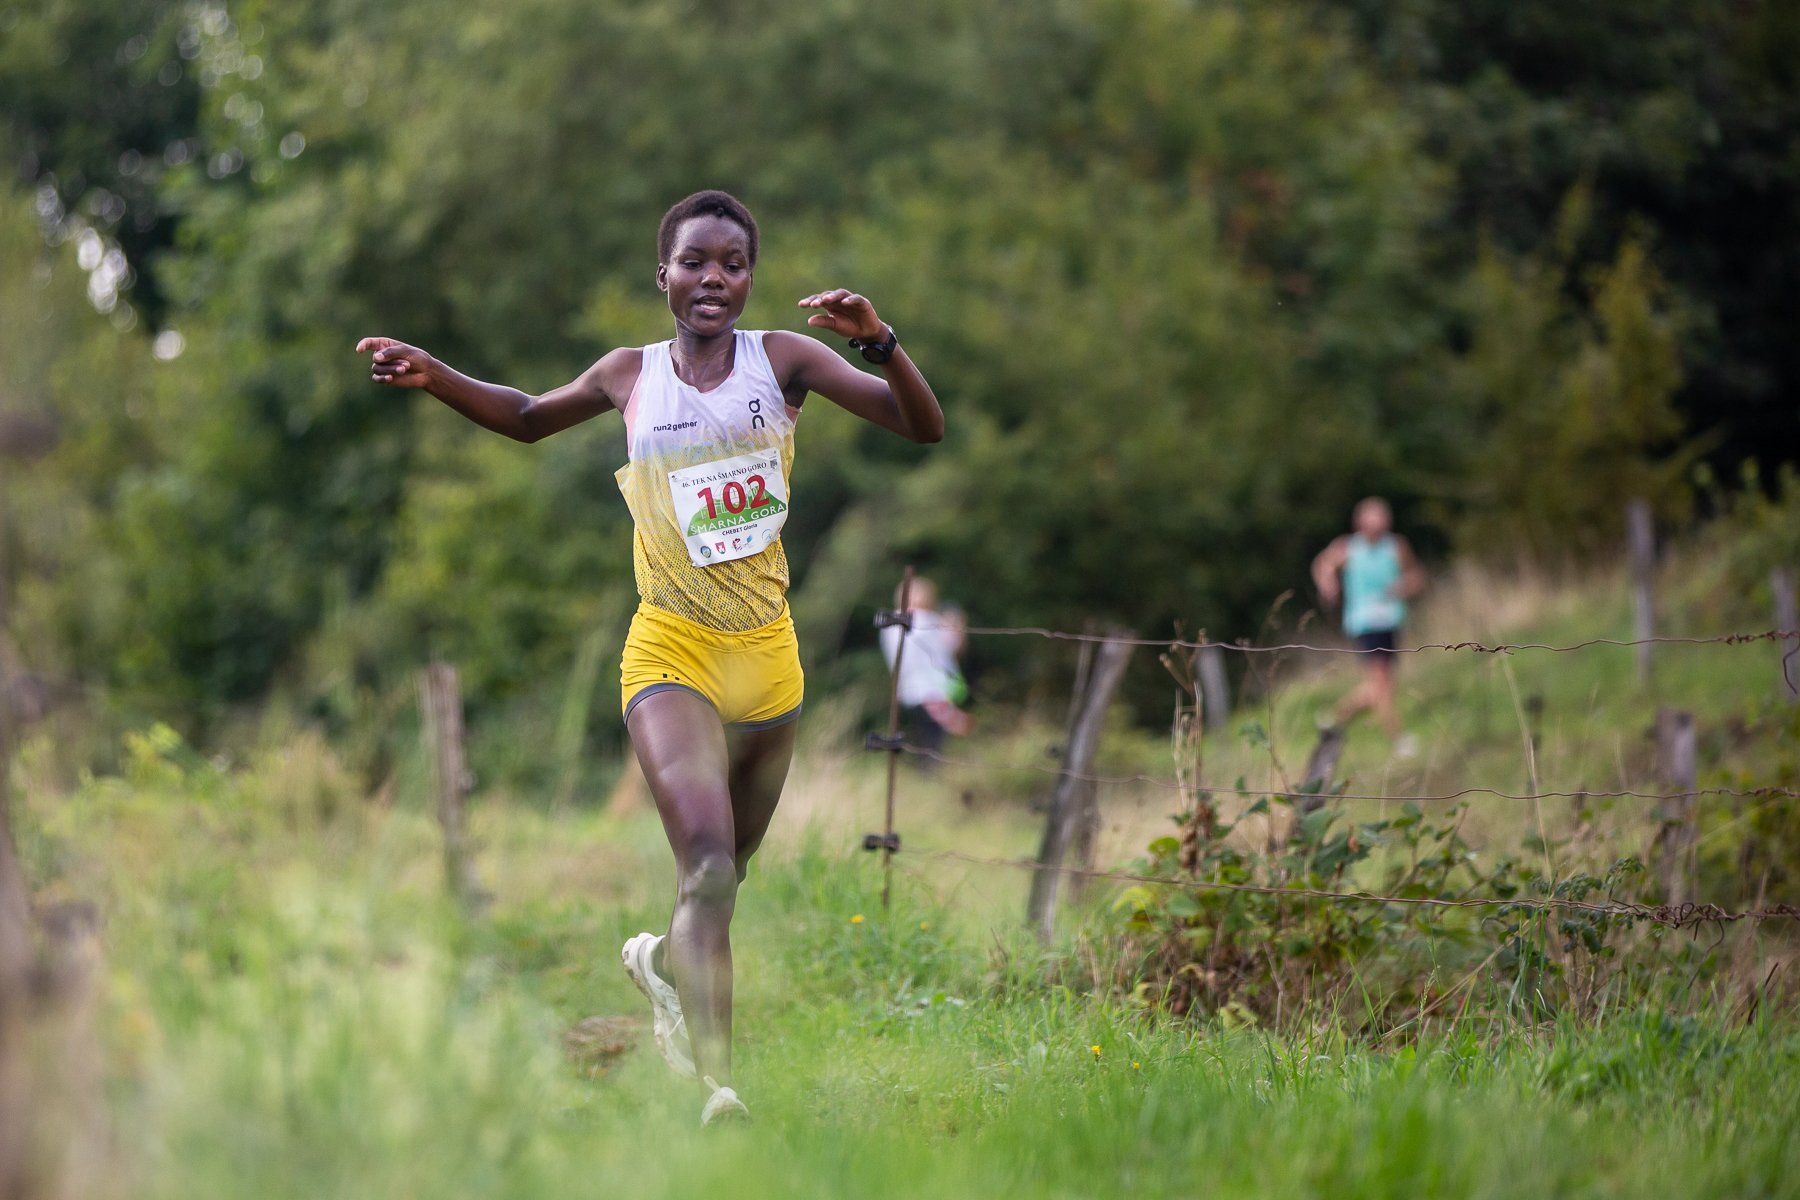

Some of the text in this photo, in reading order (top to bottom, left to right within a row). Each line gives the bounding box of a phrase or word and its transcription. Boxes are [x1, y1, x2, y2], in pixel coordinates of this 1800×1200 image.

[653, 420, 698, 432] run2gether
[692, 478, 706, 486] TEK
[718, 467, 747, 481] ŠMARNO
[747, 462, 767, 472] GORO
[697, 474, 770, 520] 102
[690, 503, 785, 535] ŠMARNA GORA
[722, 523, 758, 536] CHEBET Gloria
